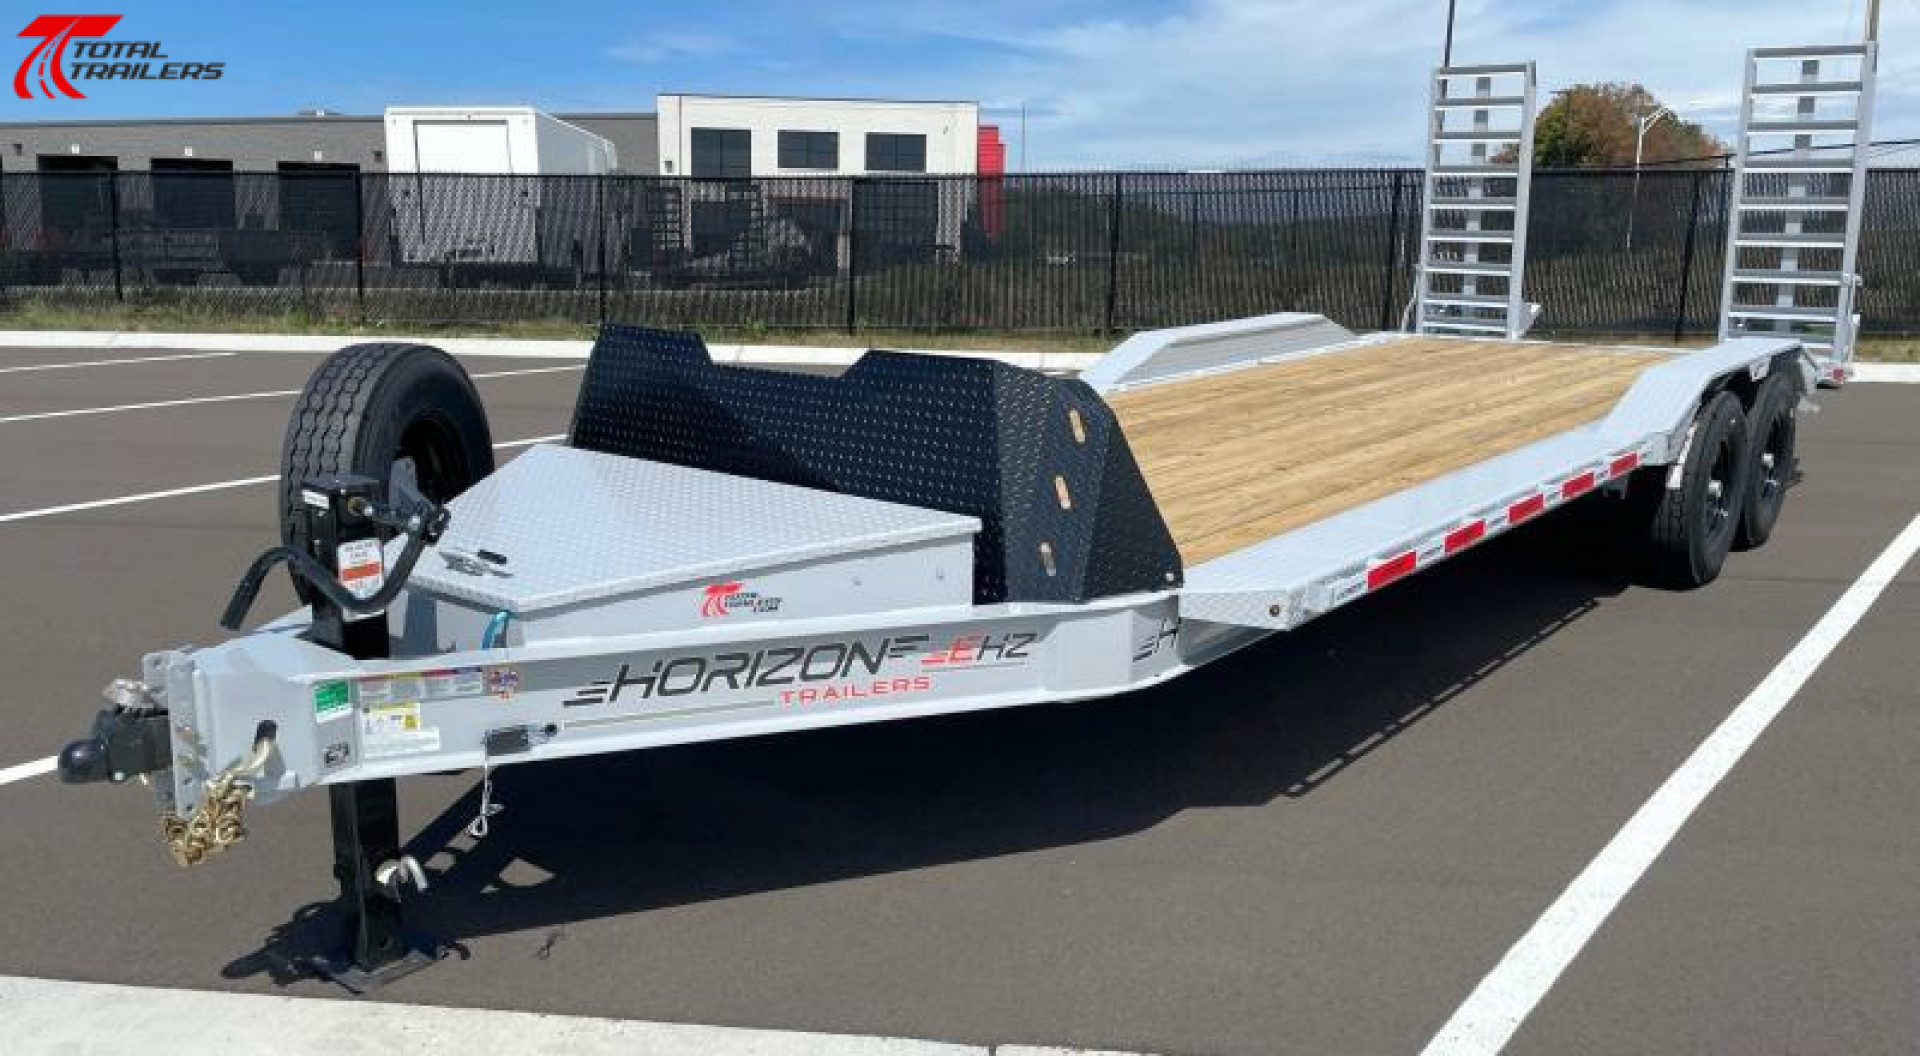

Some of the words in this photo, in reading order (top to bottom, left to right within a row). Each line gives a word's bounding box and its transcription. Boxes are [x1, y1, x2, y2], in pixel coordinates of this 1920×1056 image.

[606, 636, 893, 703] HORIZON
[945, 632, 1038, 664] EHZ
[780, 676, 930, 705] TRAILERS
